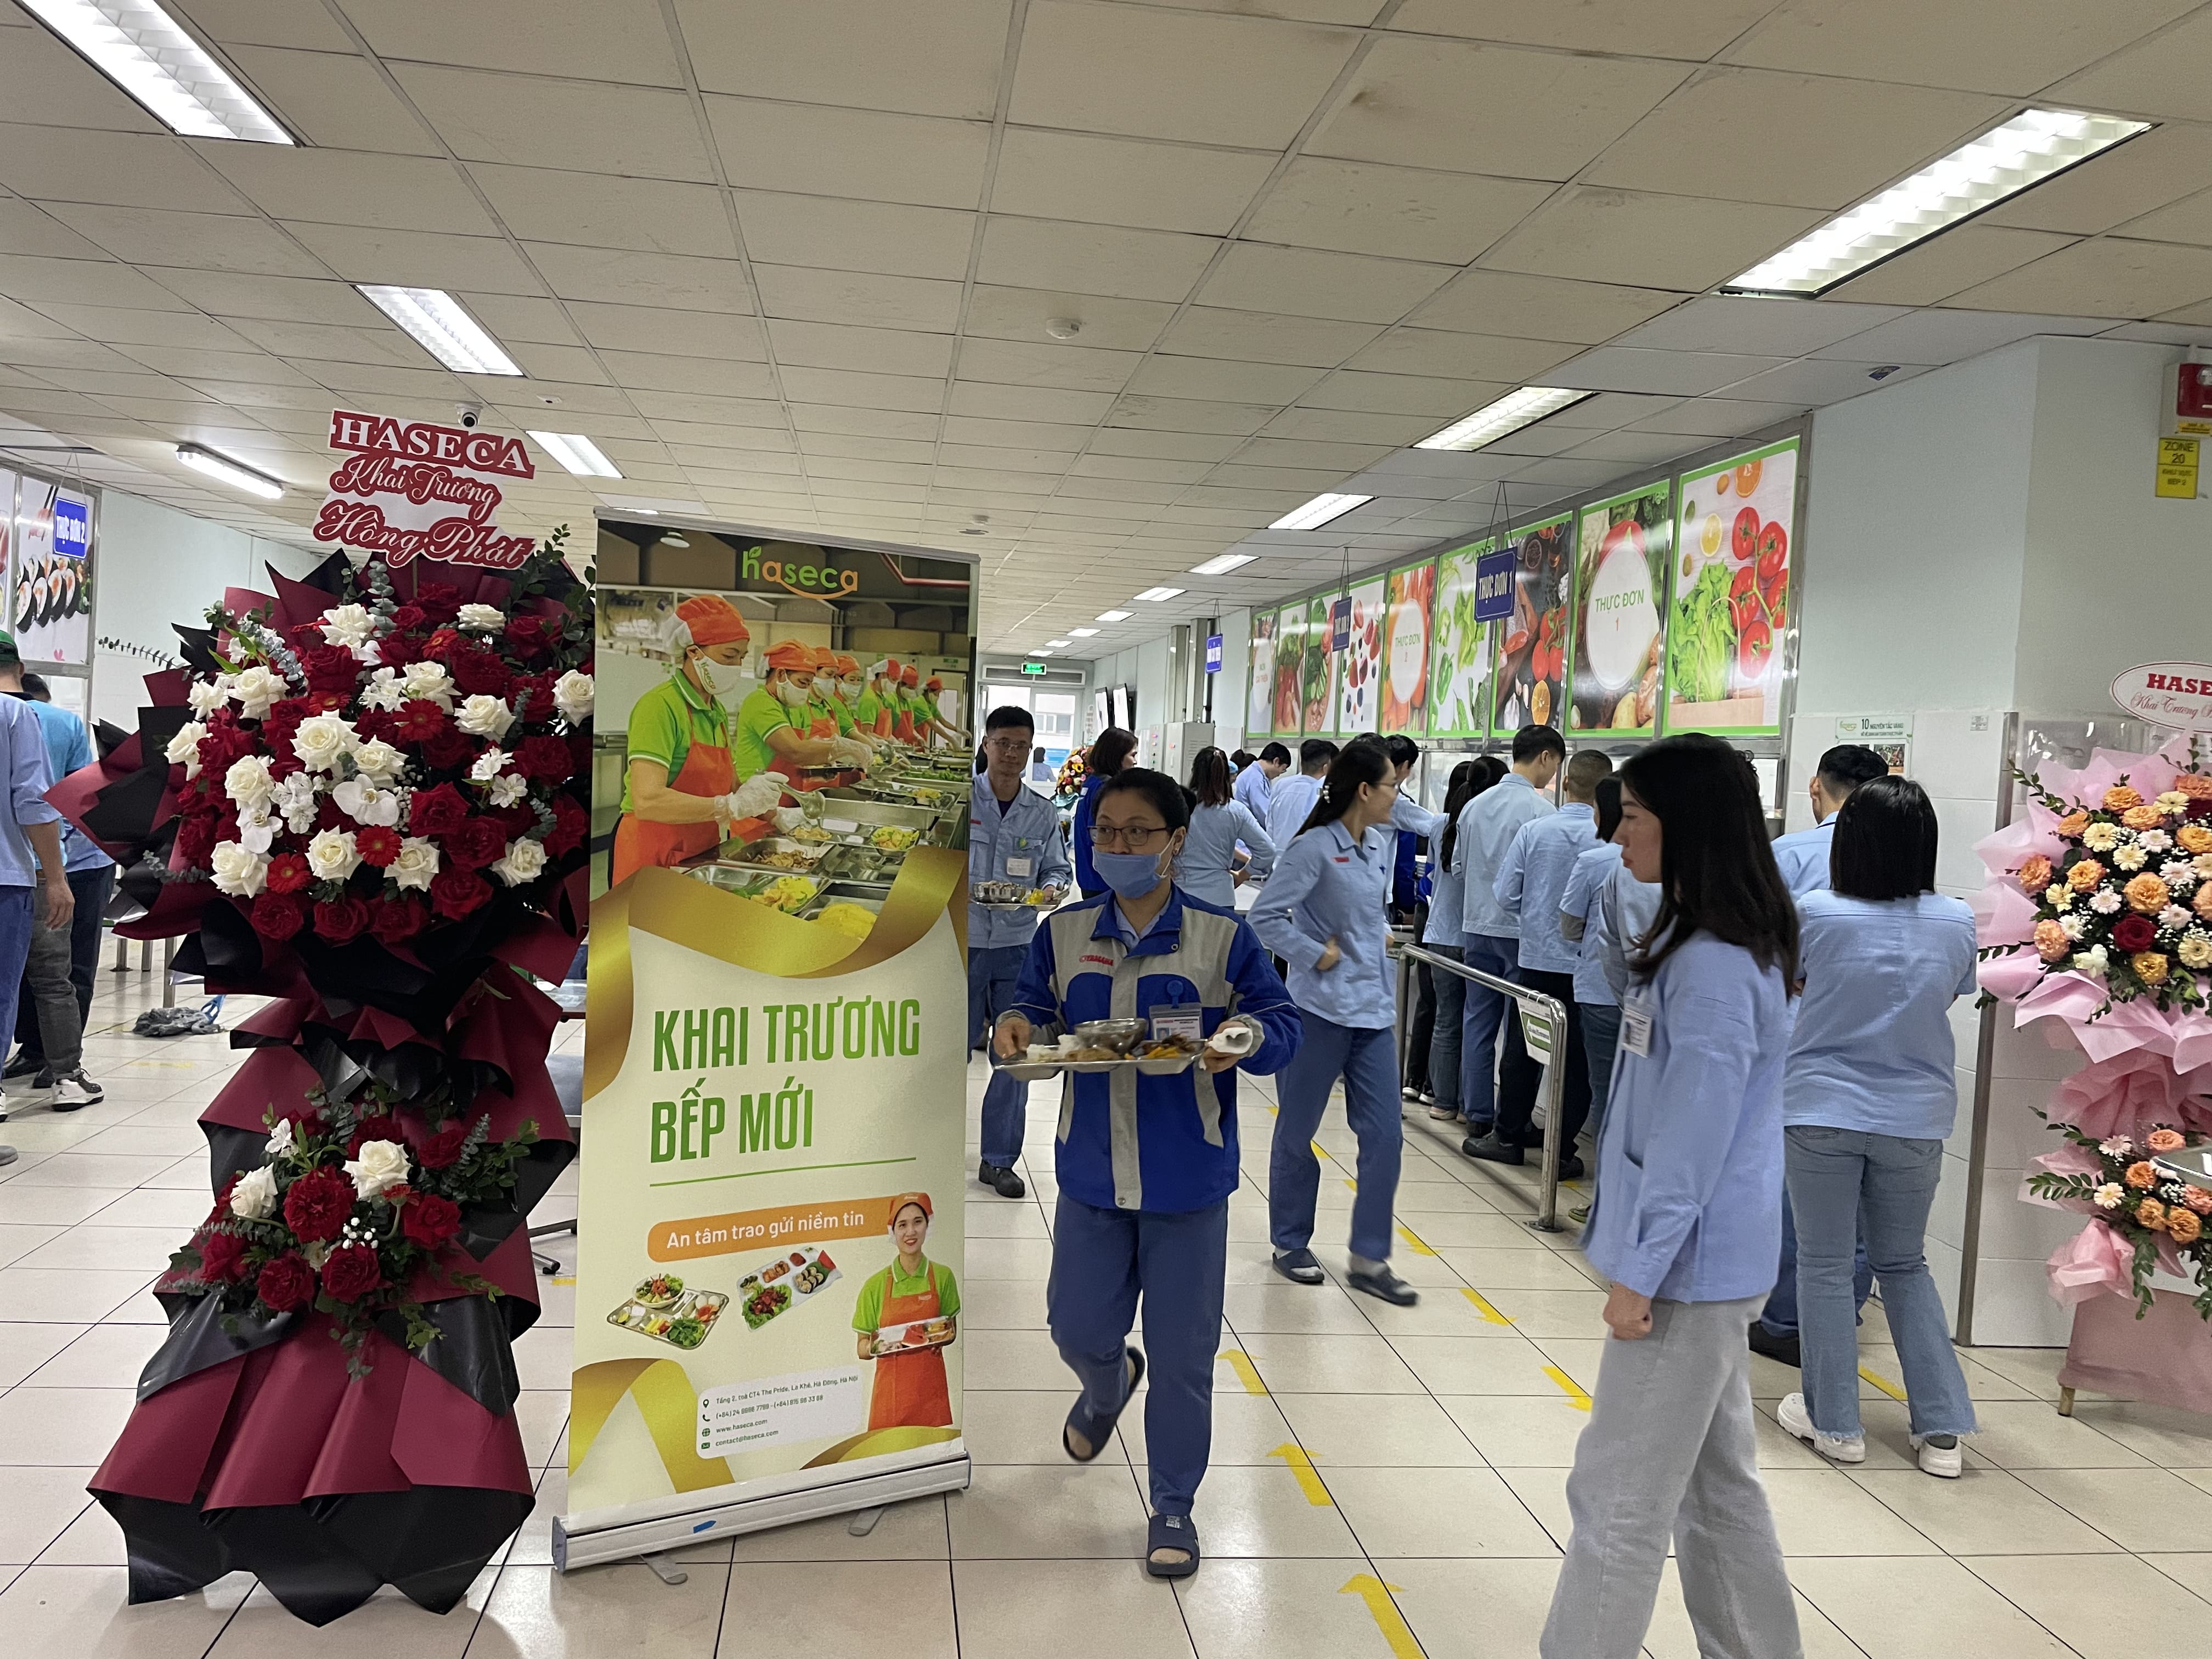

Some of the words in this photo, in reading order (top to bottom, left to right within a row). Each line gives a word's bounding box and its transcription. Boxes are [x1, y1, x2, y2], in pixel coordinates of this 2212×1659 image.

[337, 417, 528, 472] HASECA
[2164, 441, 2194, 452] ZONE
[2171, 453, 2185, 464] 20
[335, 457, 406, 492] Khai
[411, 468, 496, 521] Trương
[81, 522, 86, 544] 2
[319, 505, 420, 561] Hồng
[430, 522, 525, 564] Phát
[742, 546, 859, 600] haseca
[1479, 573, 1494, 604] THỰC
[1494, 570, 1508, 597] ĐƠN
[1509, 570, 1513, 594] 1
[1595, 594, 1620, 614] THỰC
[1622, 589, 1644, 607] ĐƠN
[1615, 617, 1619, 631] 1
[2130, 691, 2159, 710] Khai
[1861, 718, 1870, 730] 10
[653, 1006, 749, 1072] KHAI
[763, 995, 921, 1063] TRƯƠNG
[650, 1077, 725, 1164] BẾP
[738, 1076, 814, 1154] MỚI
[667, 1231, 690, 1249] An
[695, 1227, 727, 1245] tâm
[731, 1222, 765, 1240] trao
[769, 1216, 794, 1238] gửi
[798, 1211, 839, 1232] niềm
[843, 1210, 865, 1227] tin
[716, 1411, 732, 1419] (+84)
[716, 1419, 768, 1433] www.haseca.com
[715, 1430, 779, 1446] contact@haseca.com
